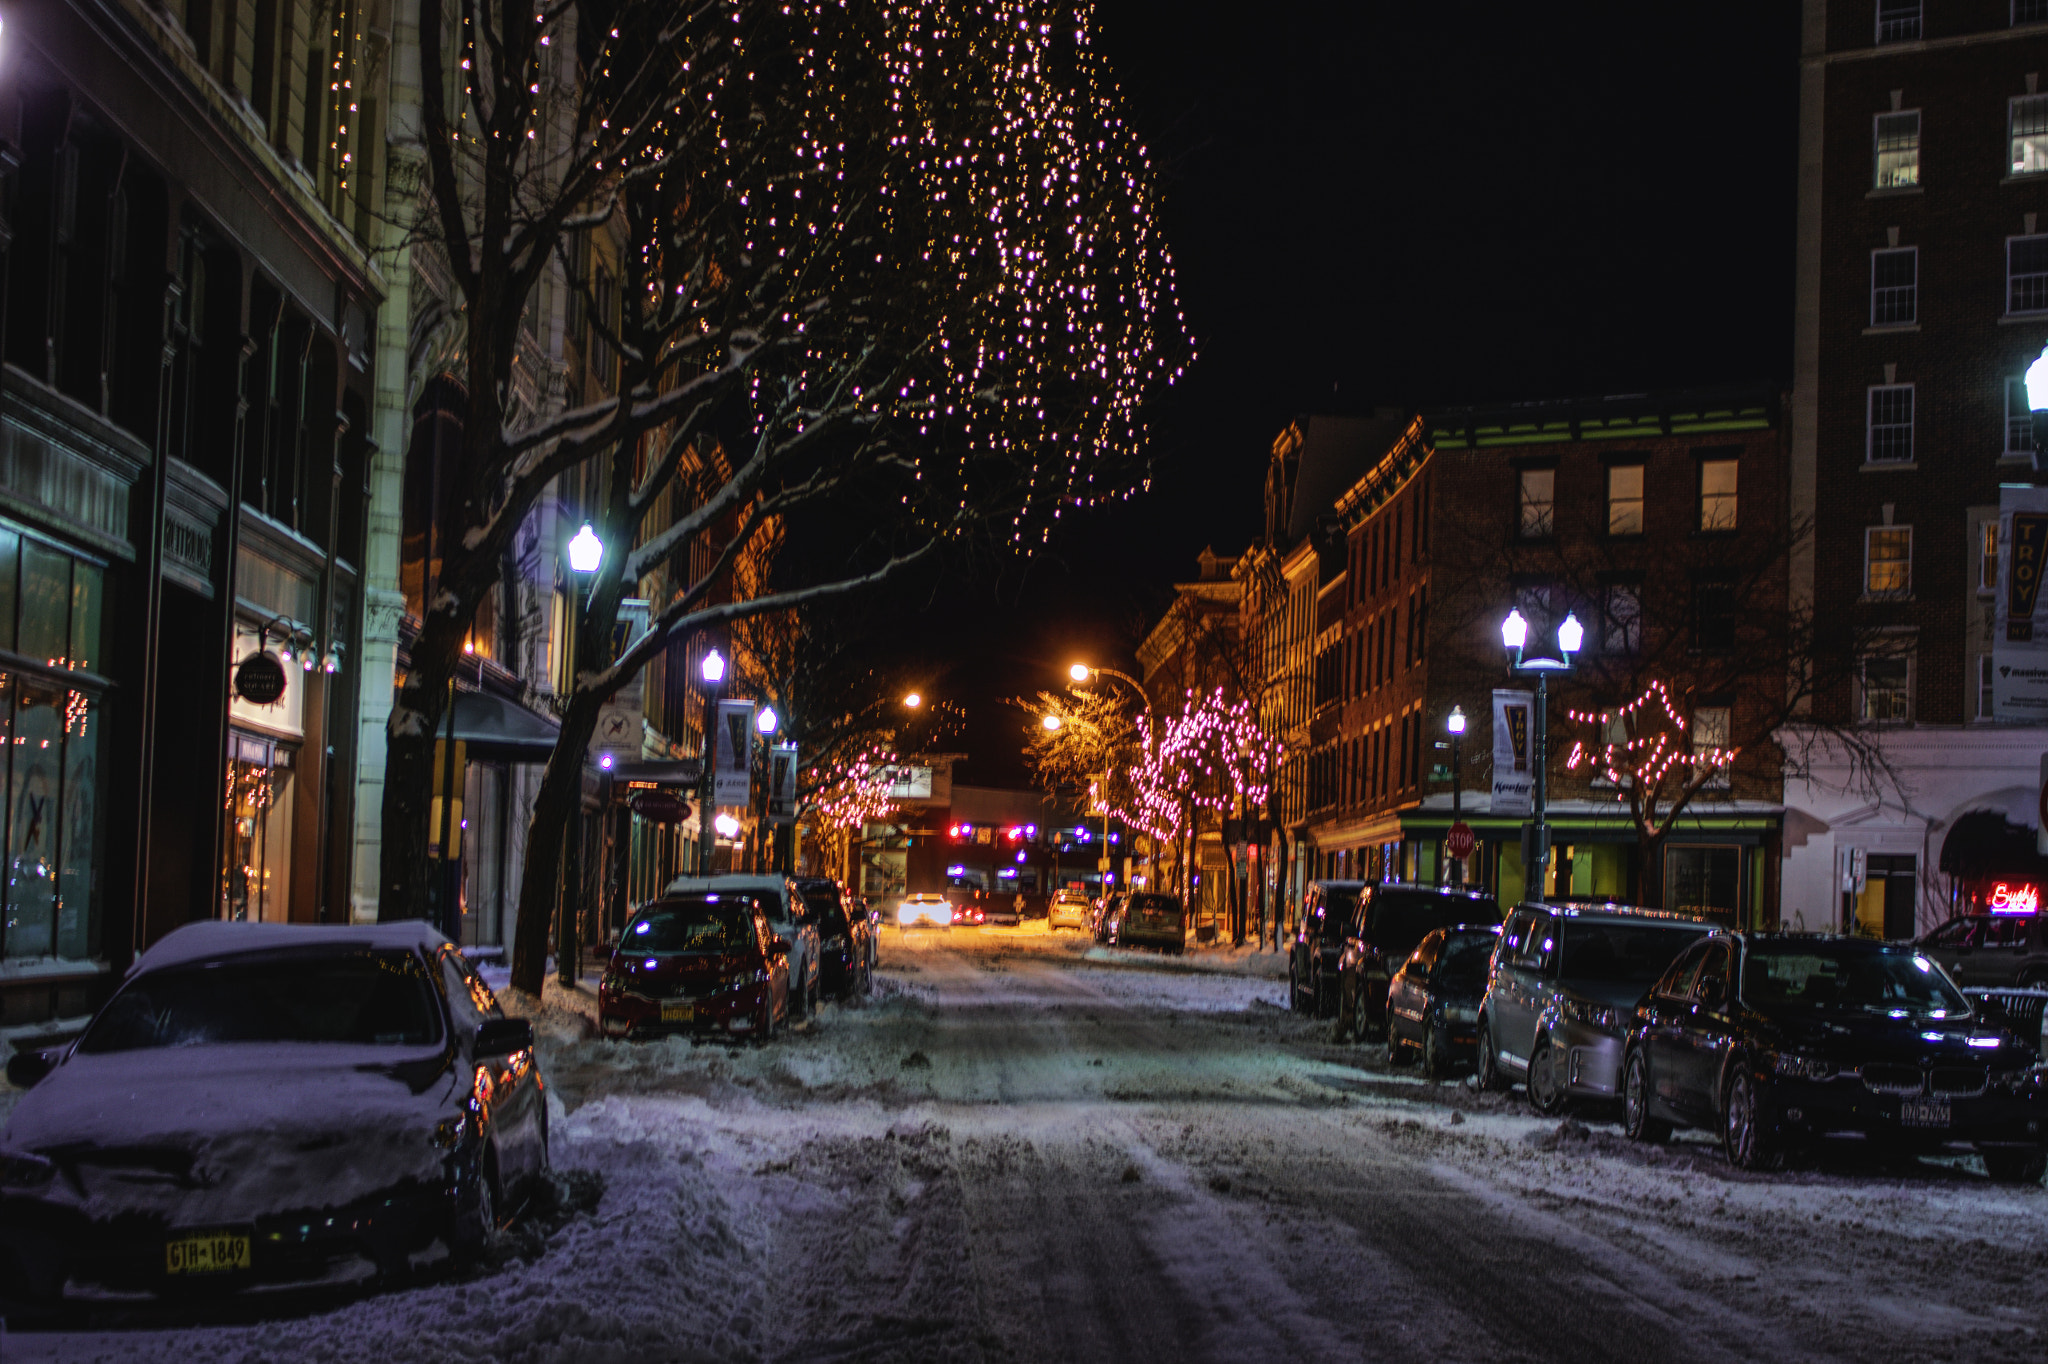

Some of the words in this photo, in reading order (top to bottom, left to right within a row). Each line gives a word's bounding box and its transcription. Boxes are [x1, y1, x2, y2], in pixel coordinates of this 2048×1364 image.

[2016, 524, 2036, 601] TROY
[2011, 626, 2028, 637] NY
[1515, 711, 1525, 752] TROY
[1495, 781, 1529, 794] Keeler
[1448, 832, 1472, 849] STOP
[1991, 882, 2038, 910] Sushi
